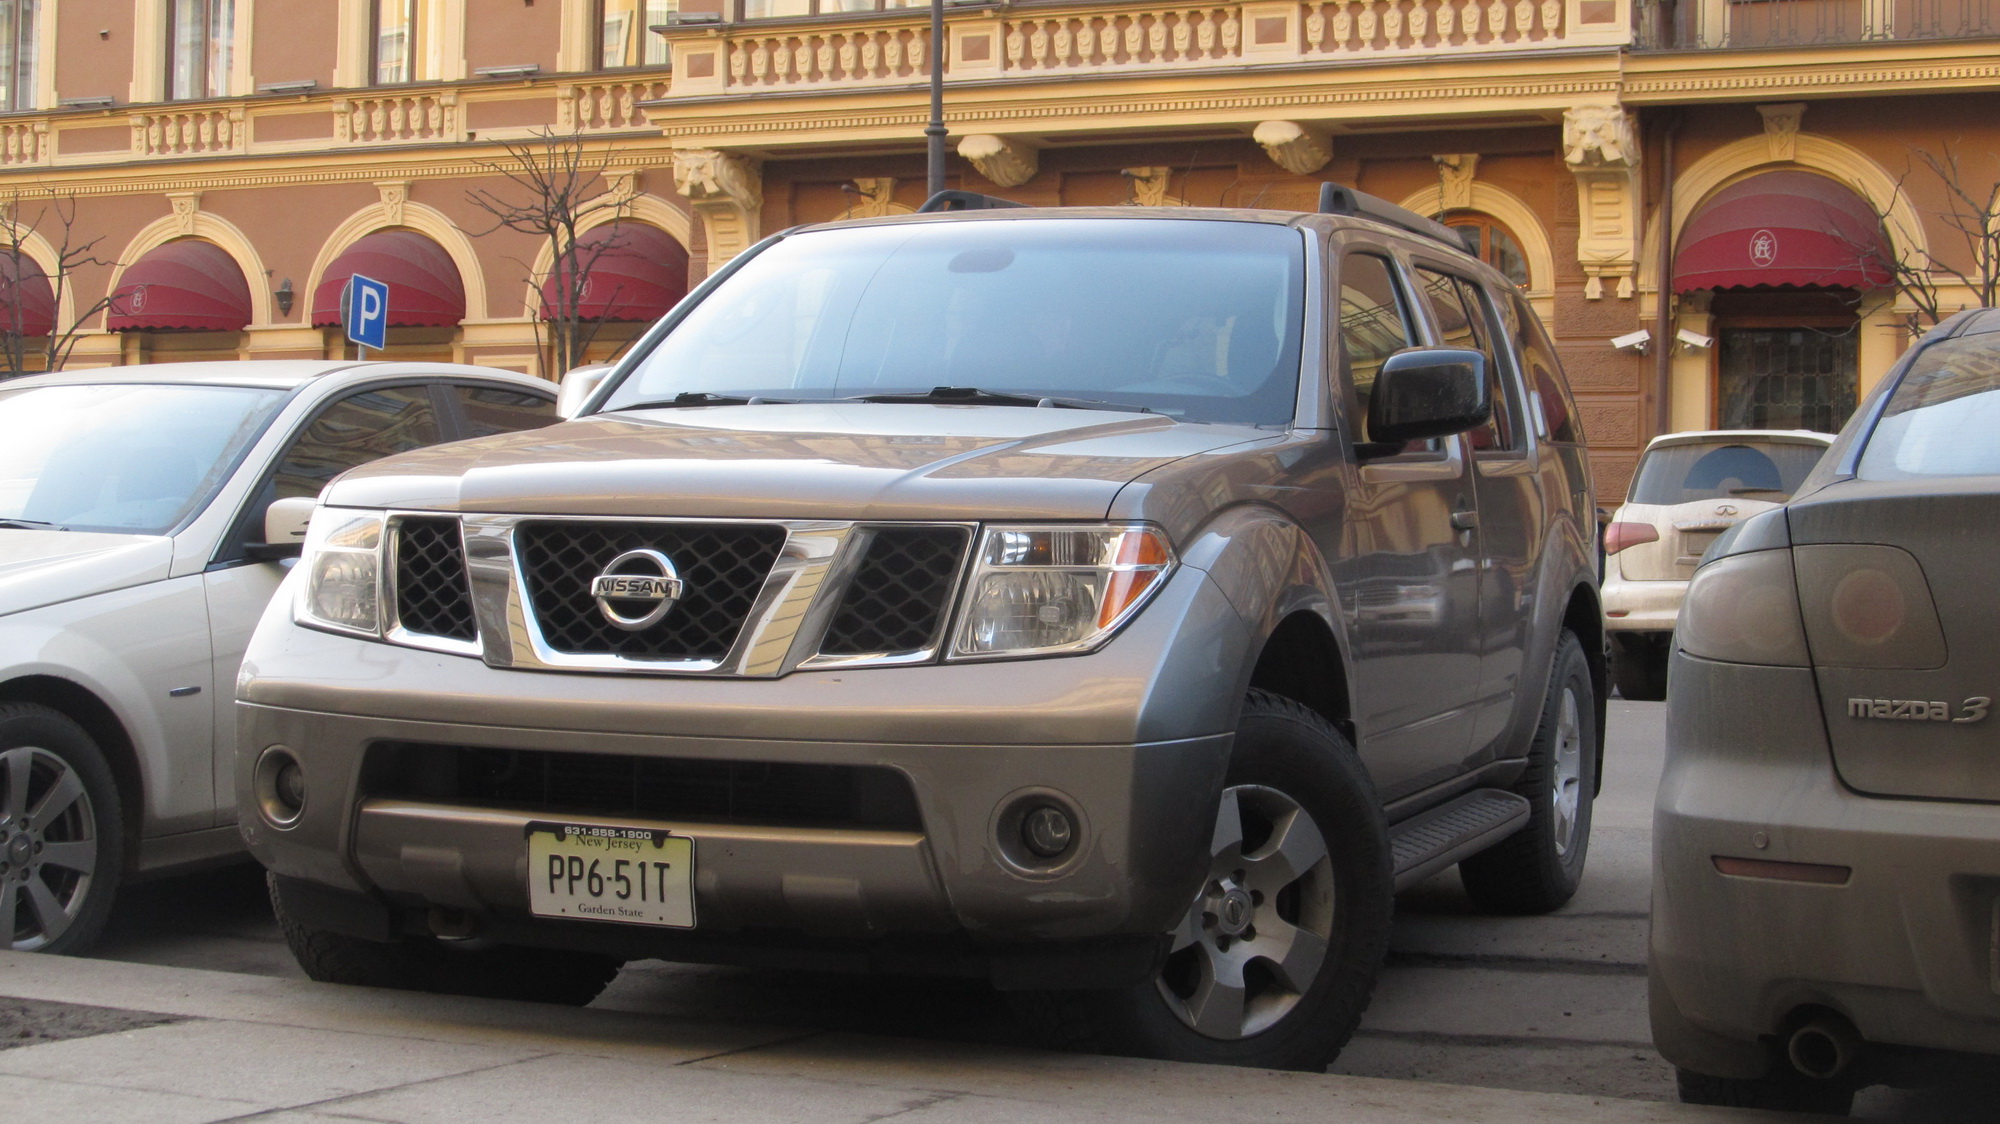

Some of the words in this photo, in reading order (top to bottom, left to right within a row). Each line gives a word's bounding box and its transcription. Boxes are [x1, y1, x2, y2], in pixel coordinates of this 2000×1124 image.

[360, 285, 381, 336] P
[597, 580, 670, 594] NISSAN
[1951, 696, 1992, 723] 3
[564, 826, 652, 840] 631-858-1900
[574, 834, 604, 847] New
[605, 837, 643, 854] Jersey
[548, 854, 670, 903] PP6-51T
[578, 903, 615, 917] Garden
[618, 907, 644, 918] State
